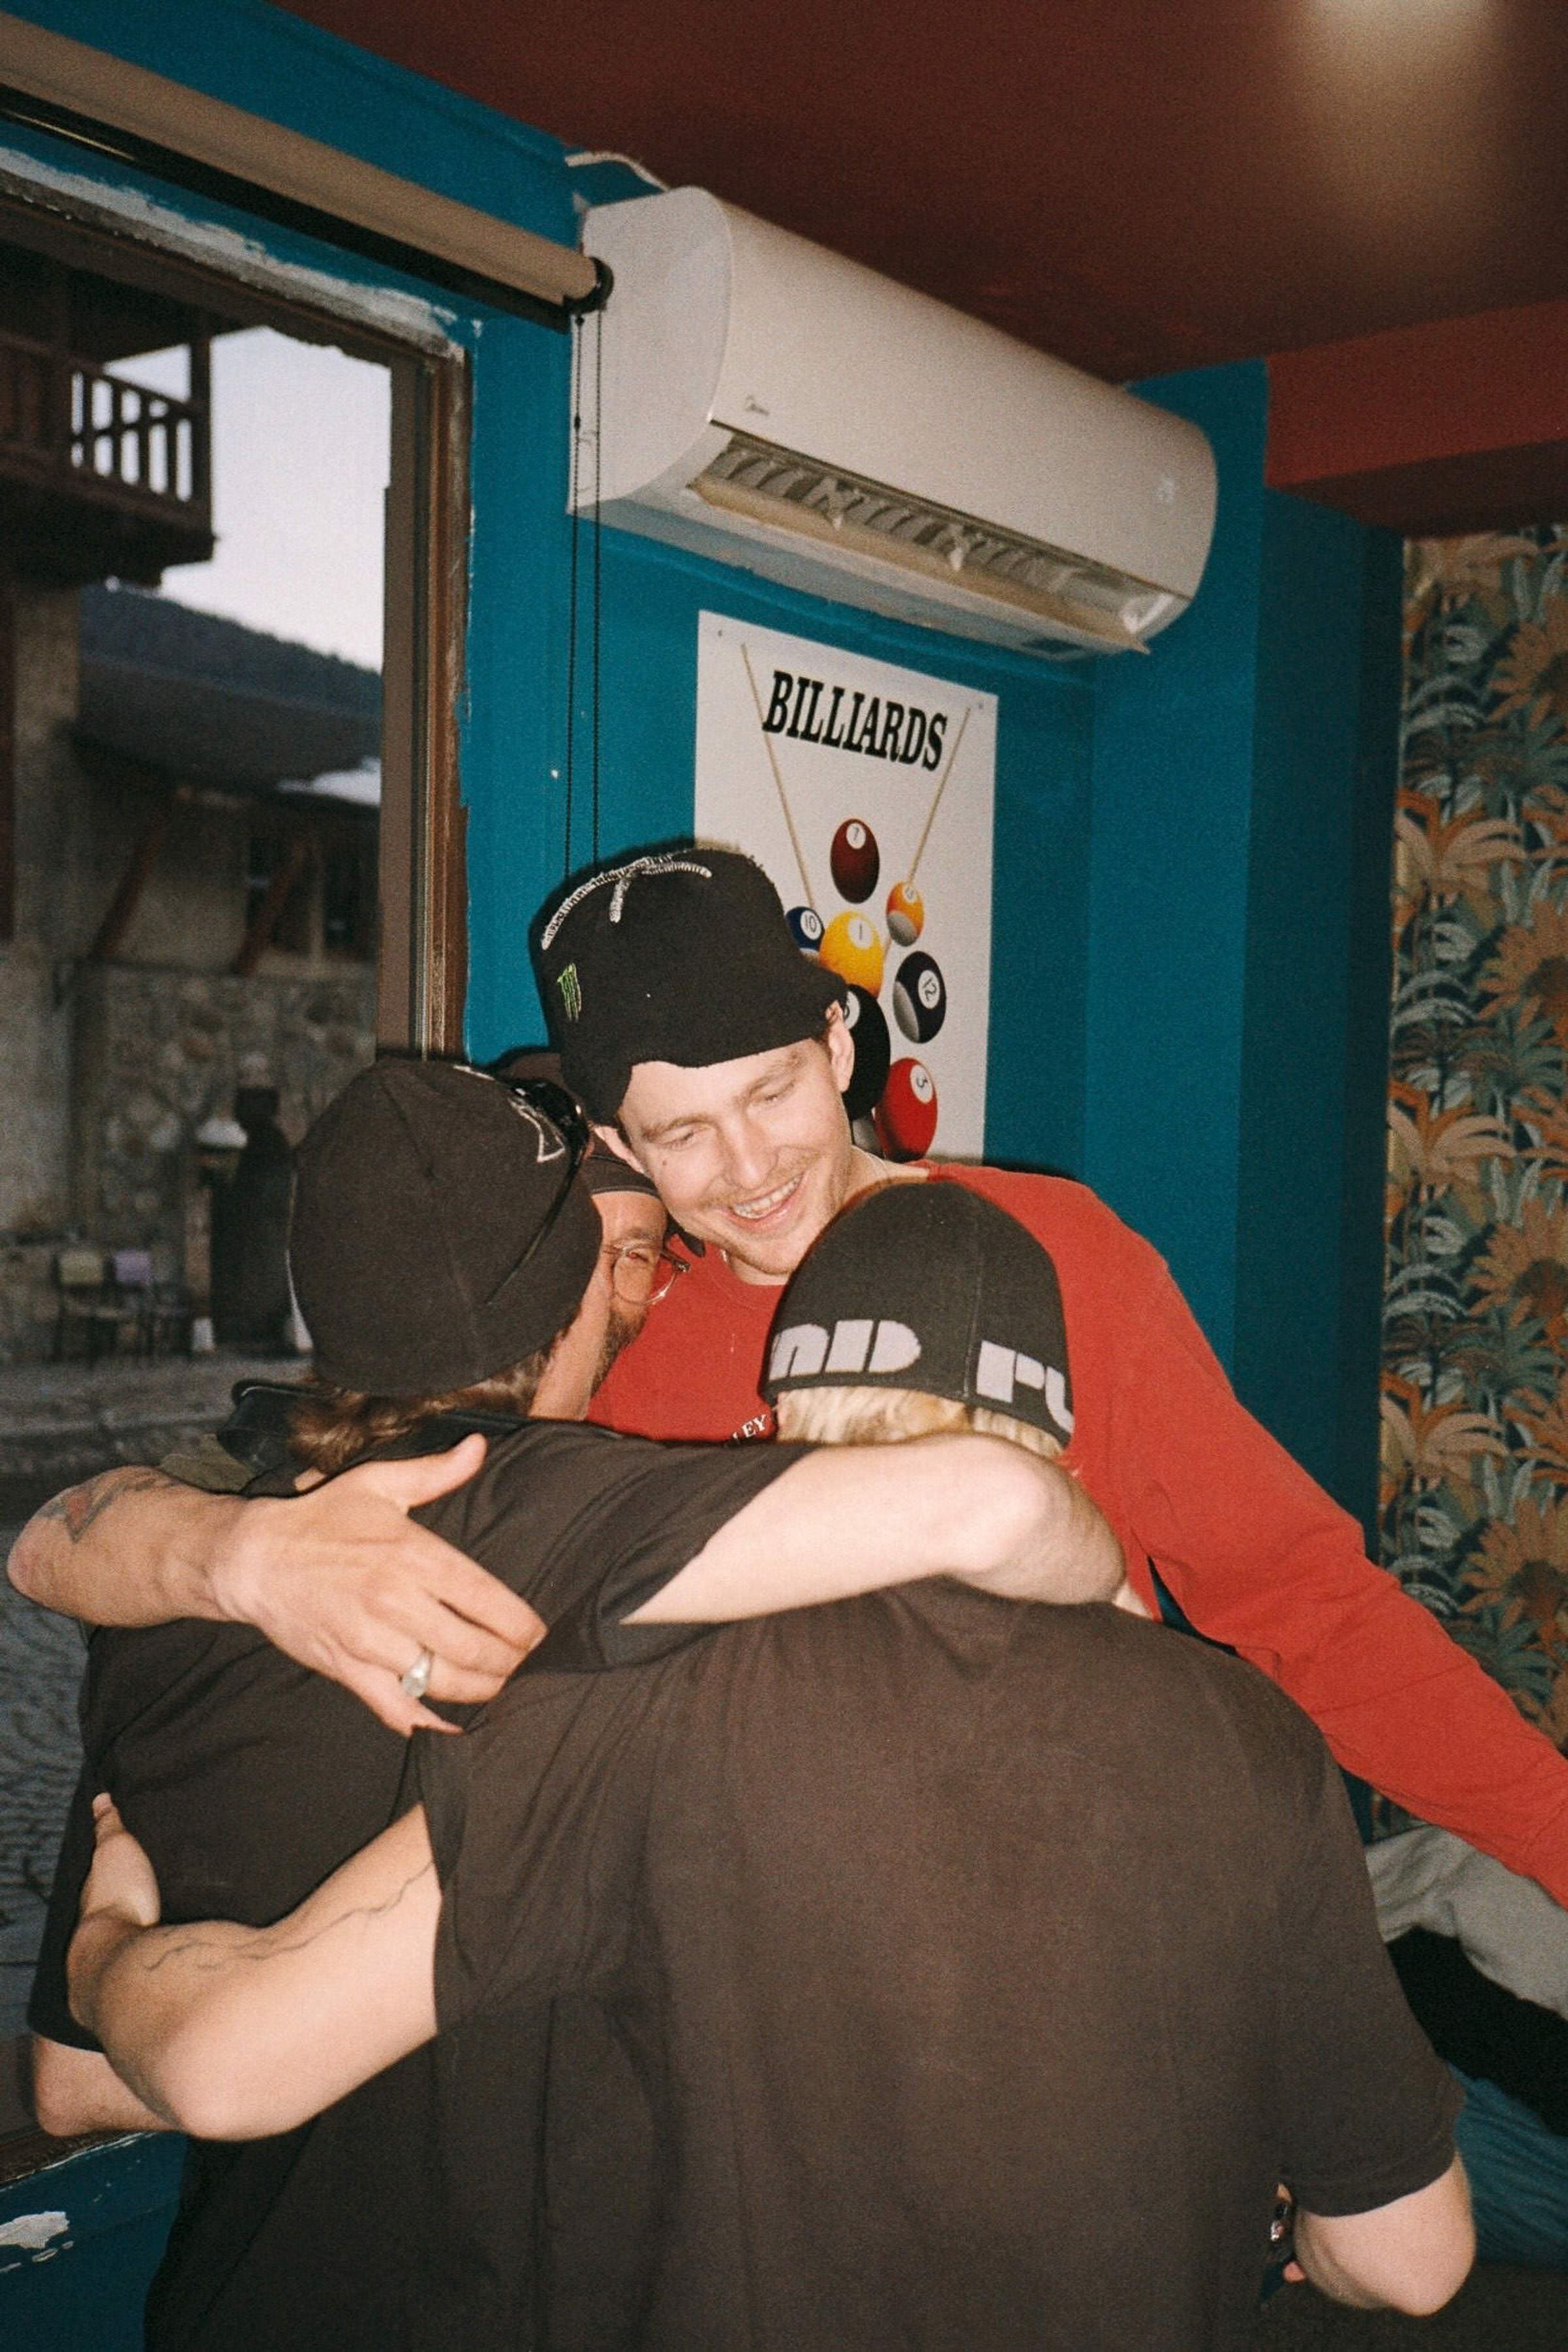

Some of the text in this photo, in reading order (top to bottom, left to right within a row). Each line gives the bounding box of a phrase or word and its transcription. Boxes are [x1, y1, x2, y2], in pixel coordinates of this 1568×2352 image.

[762, 670, 947, 771] BILLIARDS
[851, 826, 859, 841] 7
[804, 914, 817, 933] 10
[922, 977, 937, 1002] 12
